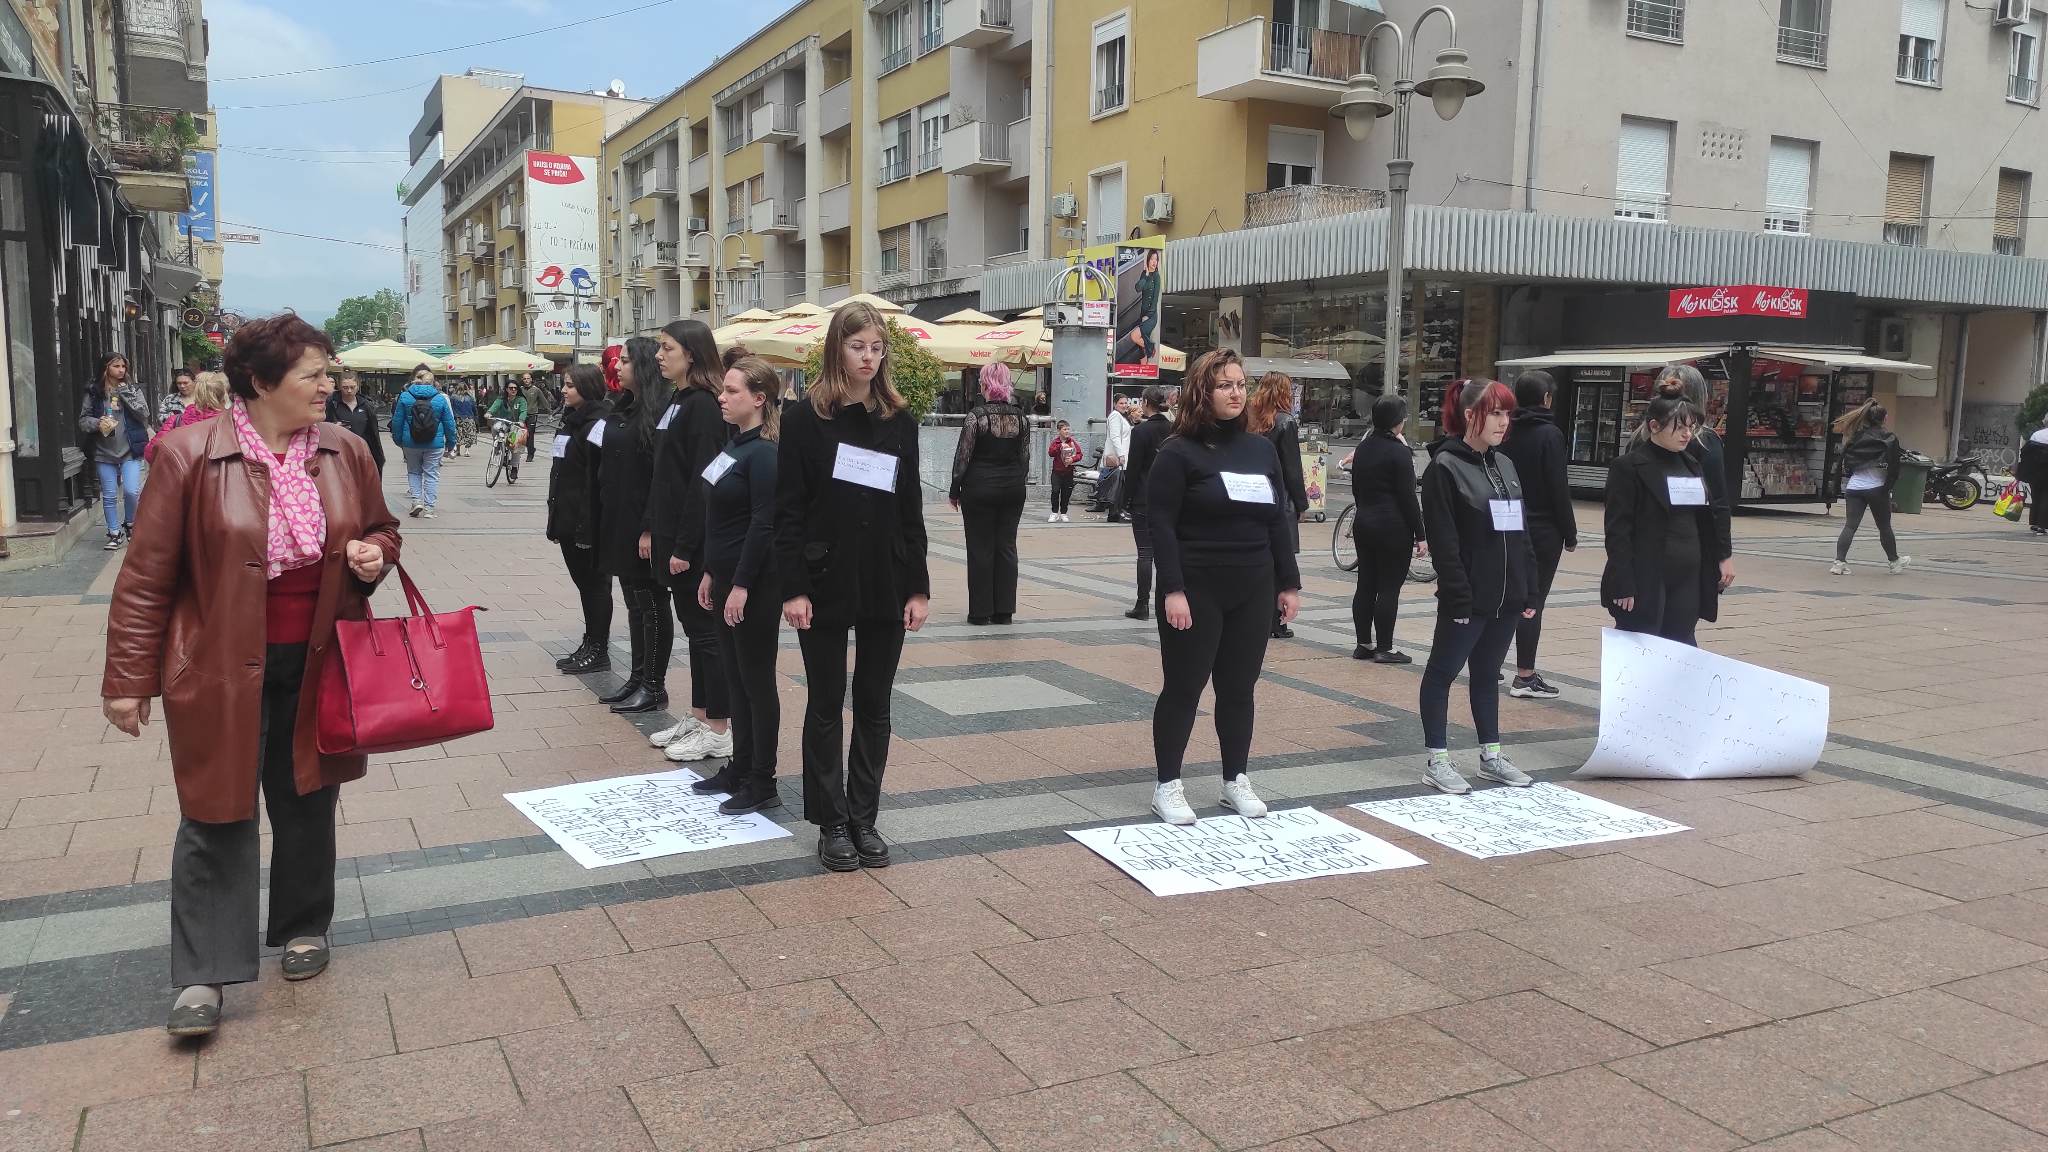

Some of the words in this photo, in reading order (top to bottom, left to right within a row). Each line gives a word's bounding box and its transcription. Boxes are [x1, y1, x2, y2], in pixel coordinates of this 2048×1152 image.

[188, 314, 200, 322] 22
[544, 320, 563, 328] IDEA
[566, 321, 591, 329] RDA
[555, 329, 591, 337] Merctor
[1356, 798, 1450, 814] FEMICID
[1097, 813, 1318, 844] ZAHTEVAMO
[1431, 832, 1476, 844] OD
[1474, 820, 1558, 837] STRANE
[1121, 832, 1273, 858] CENTRALNU
[1124, 849, 1252, 870] EVIDENCIJU
[1259, 845, 1278, 853] O
[1288, 833, 1361, 849] NASILJU
[1463, 837, 1547, 855] BLISKE
[1181, 863, 1245, 878] NAD
[1205, 878, 1222, 886] I
[1231, 855, 1381, 881] FEMICIDU!
